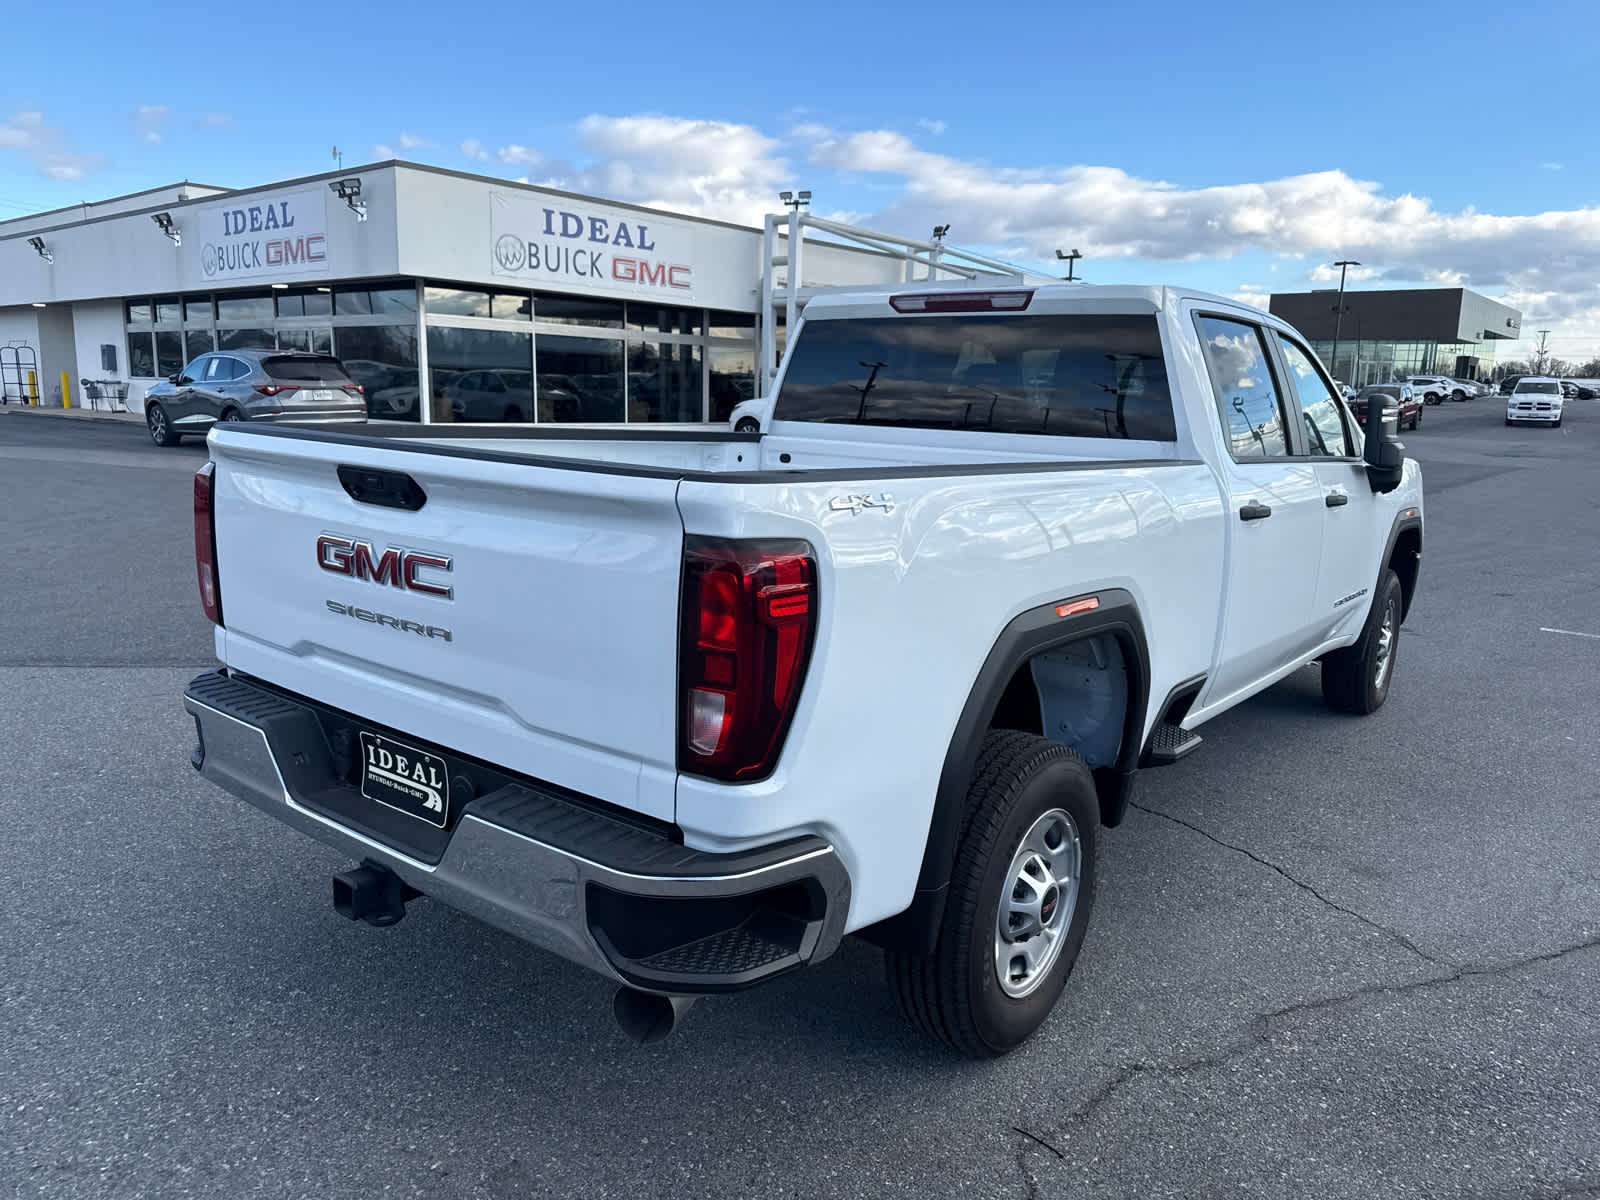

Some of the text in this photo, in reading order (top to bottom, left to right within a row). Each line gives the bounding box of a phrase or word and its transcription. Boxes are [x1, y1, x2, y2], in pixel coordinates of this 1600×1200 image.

[224, 202, 294, 236] IDEAL
[543, 208, 655, 251] IDEAL
[218, 236, 325, 271] BUICK GMC
[528, 242, 691, 288] BUICK GMC
[317, 535, 454, 600] GMC
[326, 600, 452, 642] SIERRA
[368, 744, 442, 789] IDEAL
